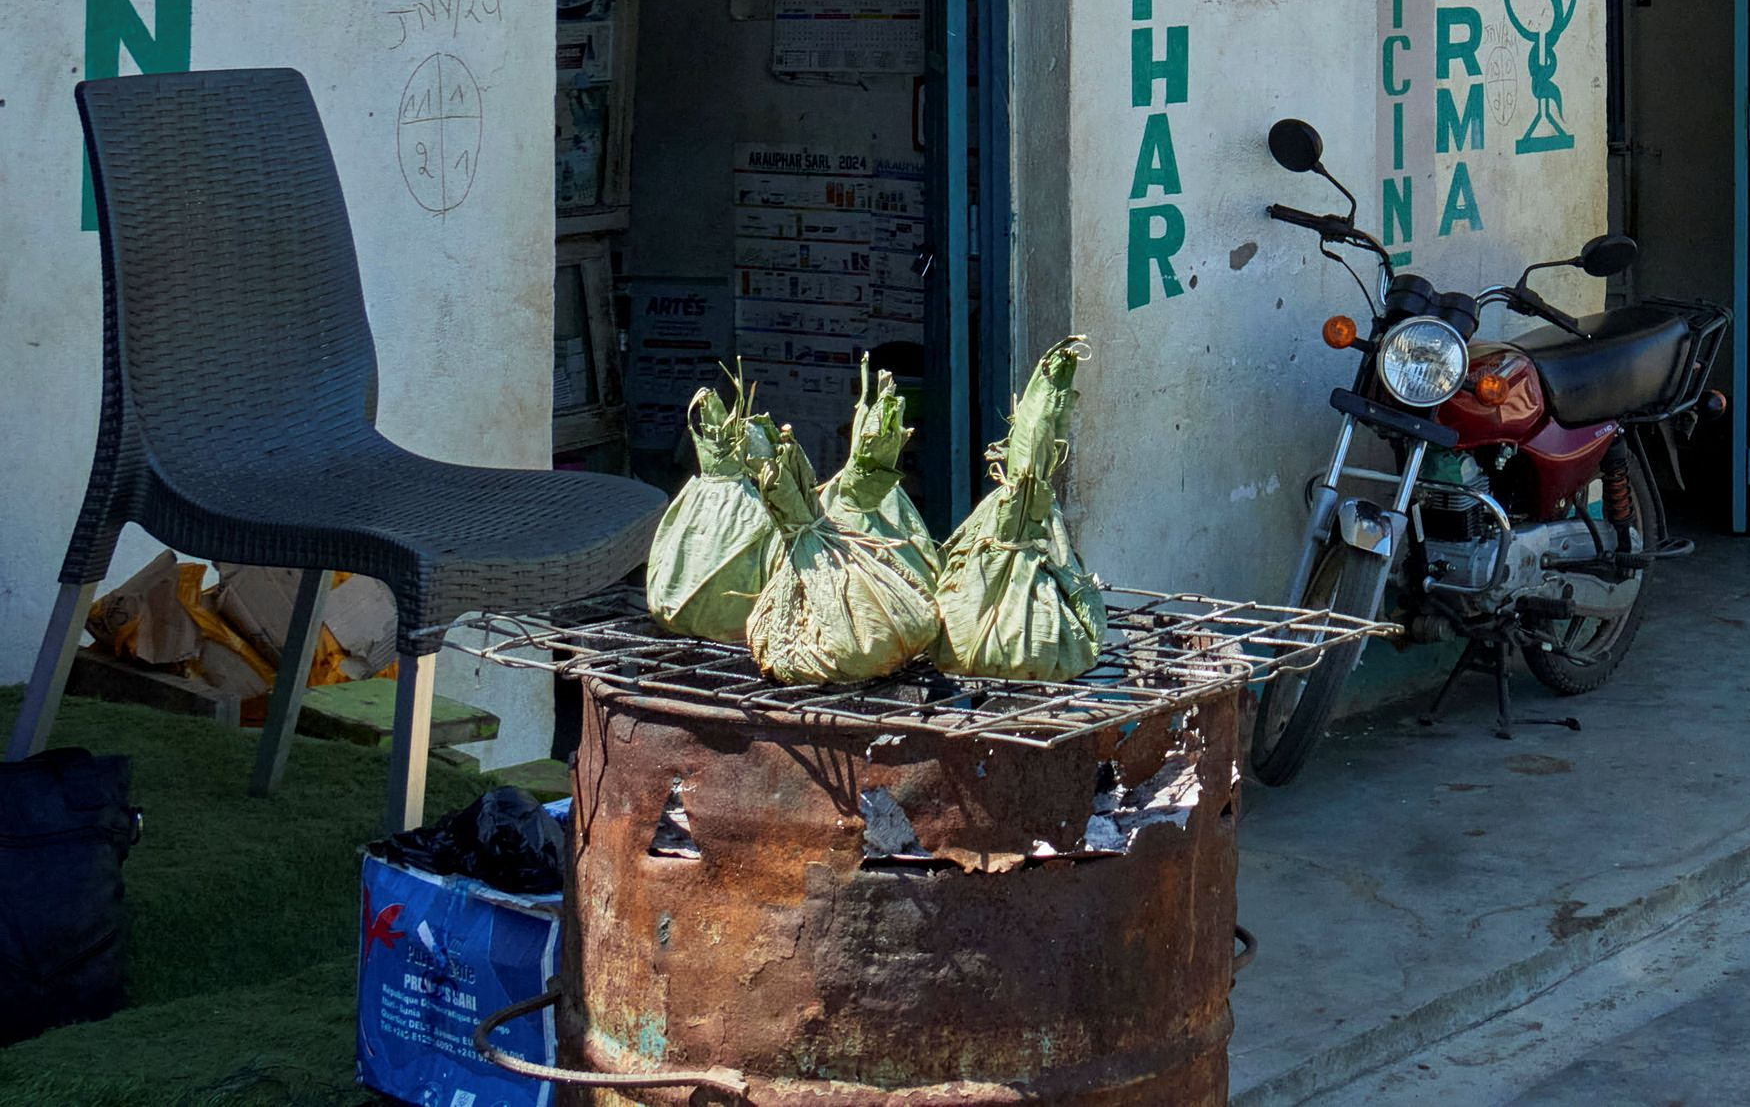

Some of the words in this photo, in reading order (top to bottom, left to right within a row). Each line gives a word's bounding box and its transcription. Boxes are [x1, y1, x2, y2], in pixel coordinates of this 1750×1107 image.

[749, 151, 801, 168] ARAUPHAR
[804, 153, 831, 169] SARL
[839, 155, 867, 170] 2024
